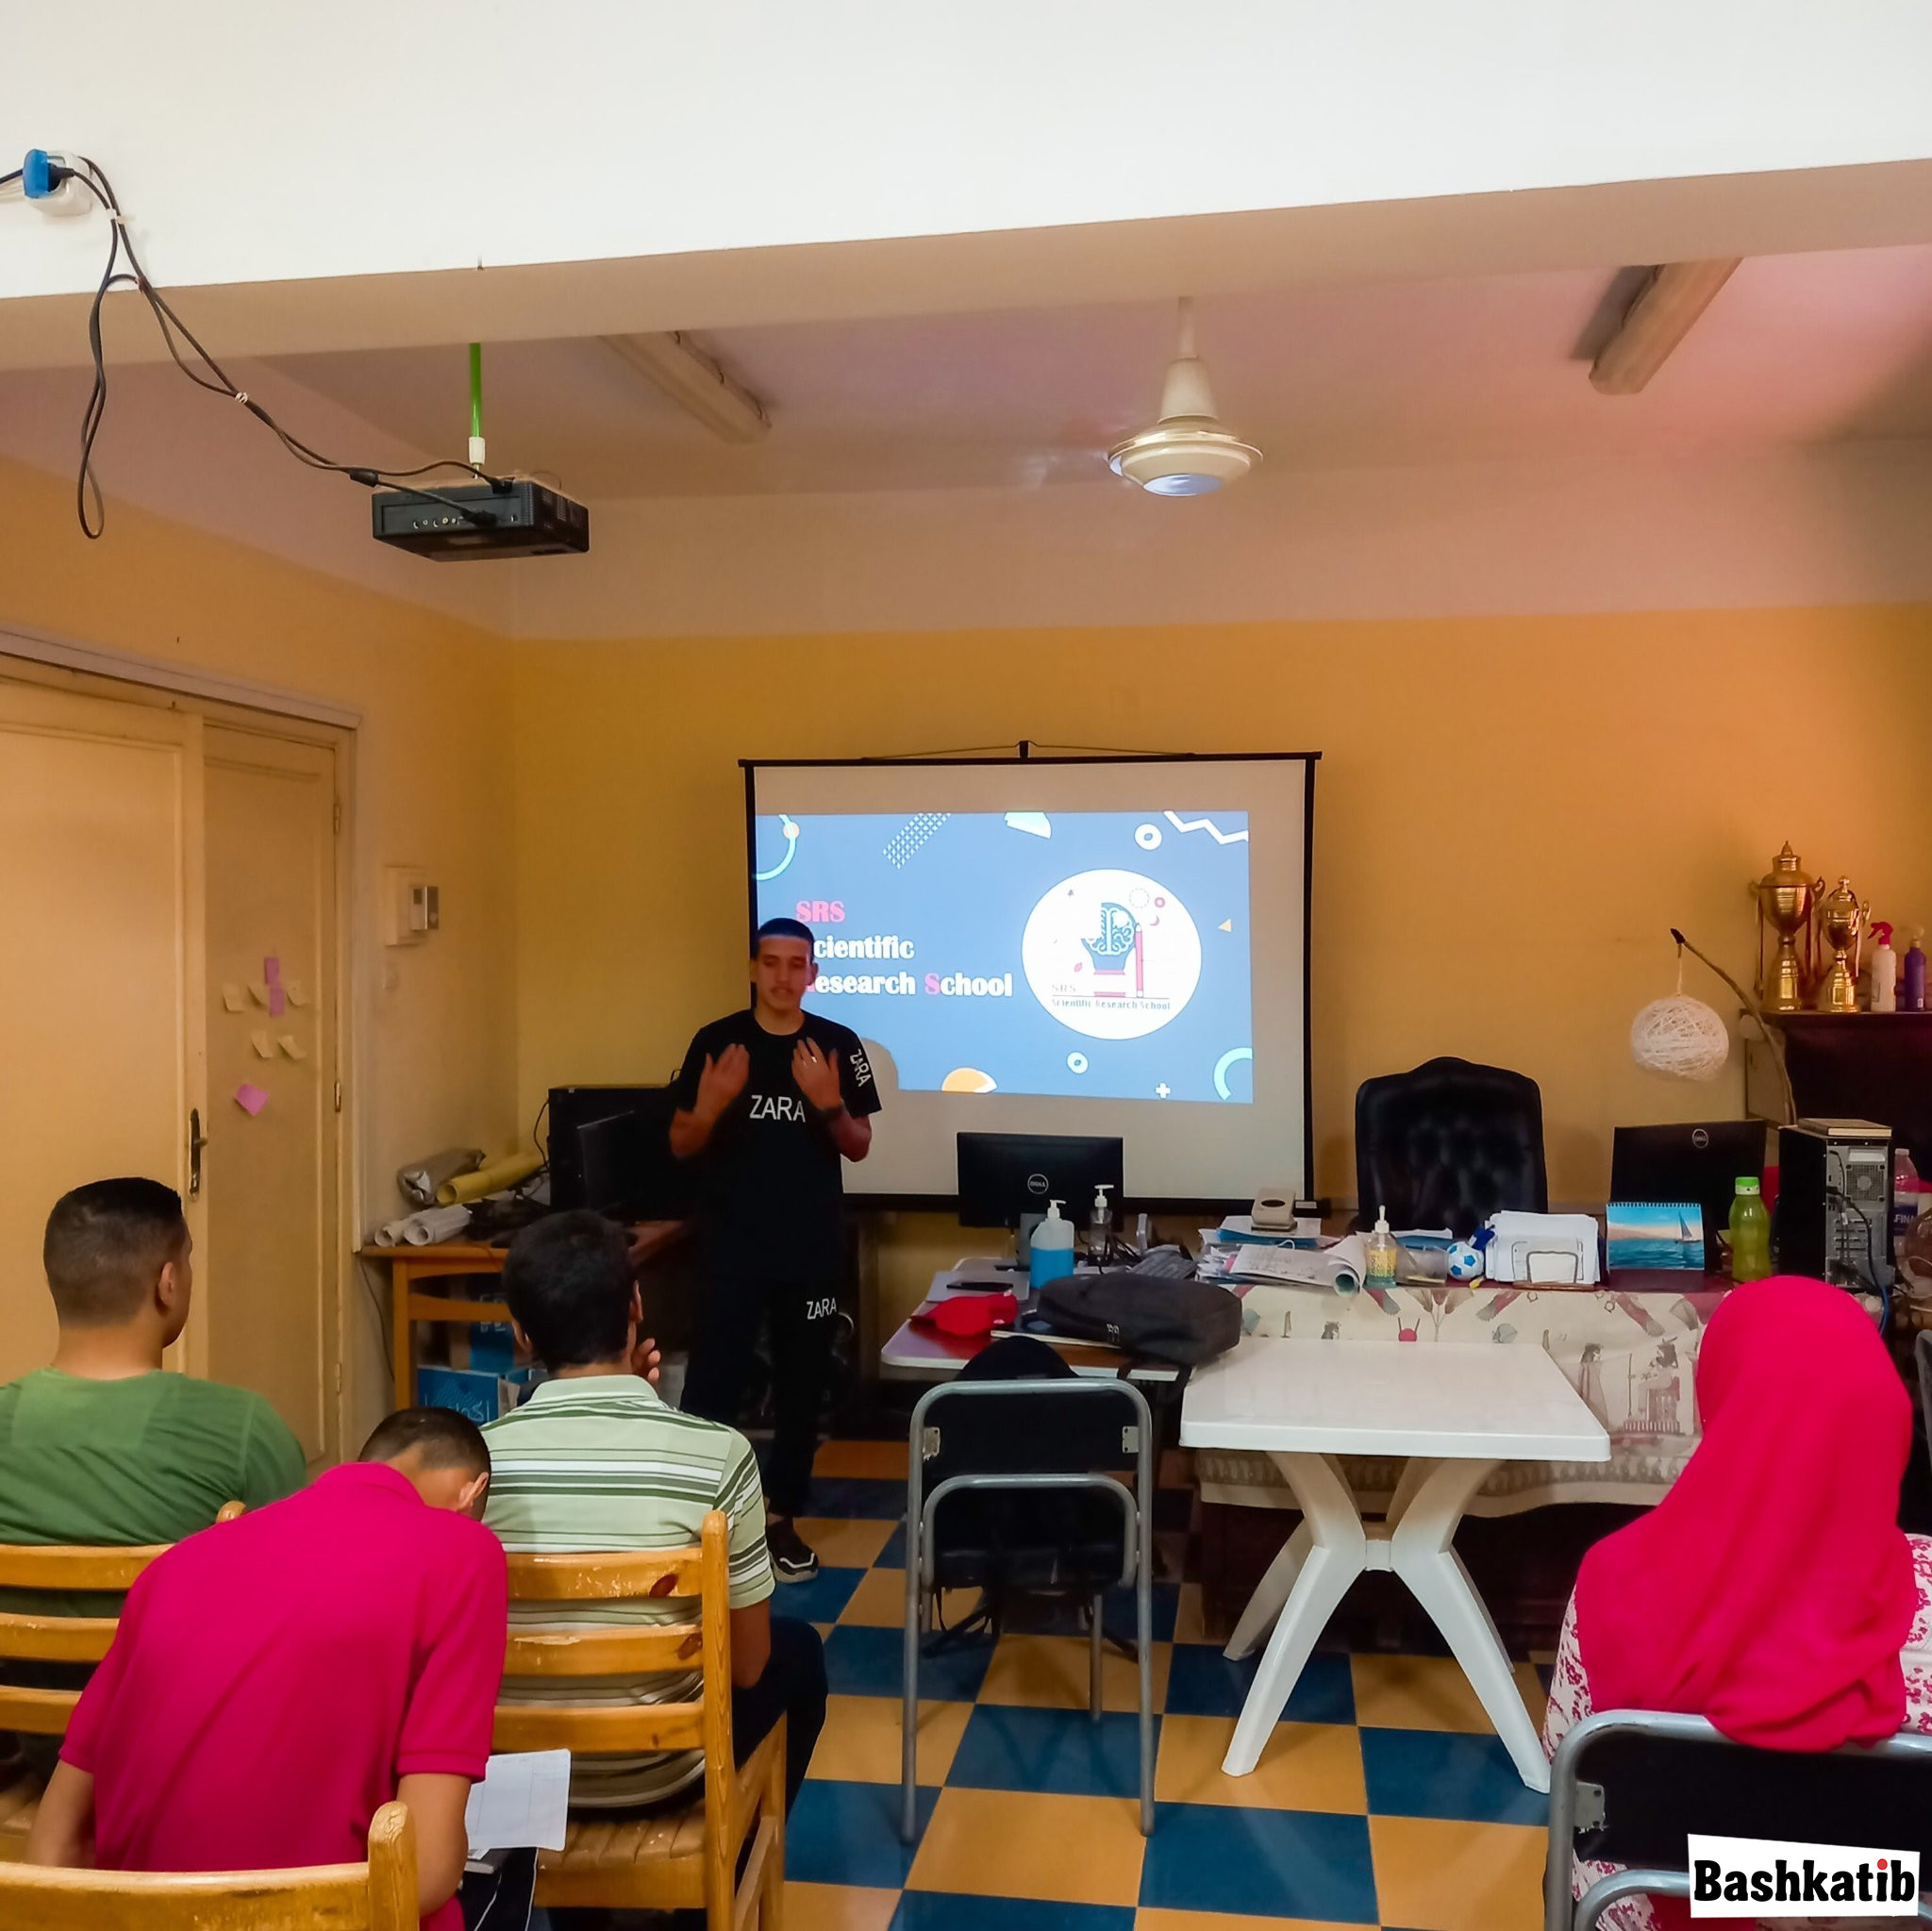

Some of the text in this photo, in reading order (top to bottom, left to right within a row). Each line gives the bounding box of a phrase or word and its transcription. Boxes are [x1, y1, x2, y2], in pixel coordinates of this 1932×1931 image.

[795, 900, 845, 924] SRS
[813, 935, 915, 959] cientific
[807, 972, 1013, 997] esearch School
[1140, 1001, 1171, 1010] School
[849, 1048, 872, 1088] ZARA
[749, 1094, 806, 1123] ZARA
[807, 1297, 837, 1320] ZARA
